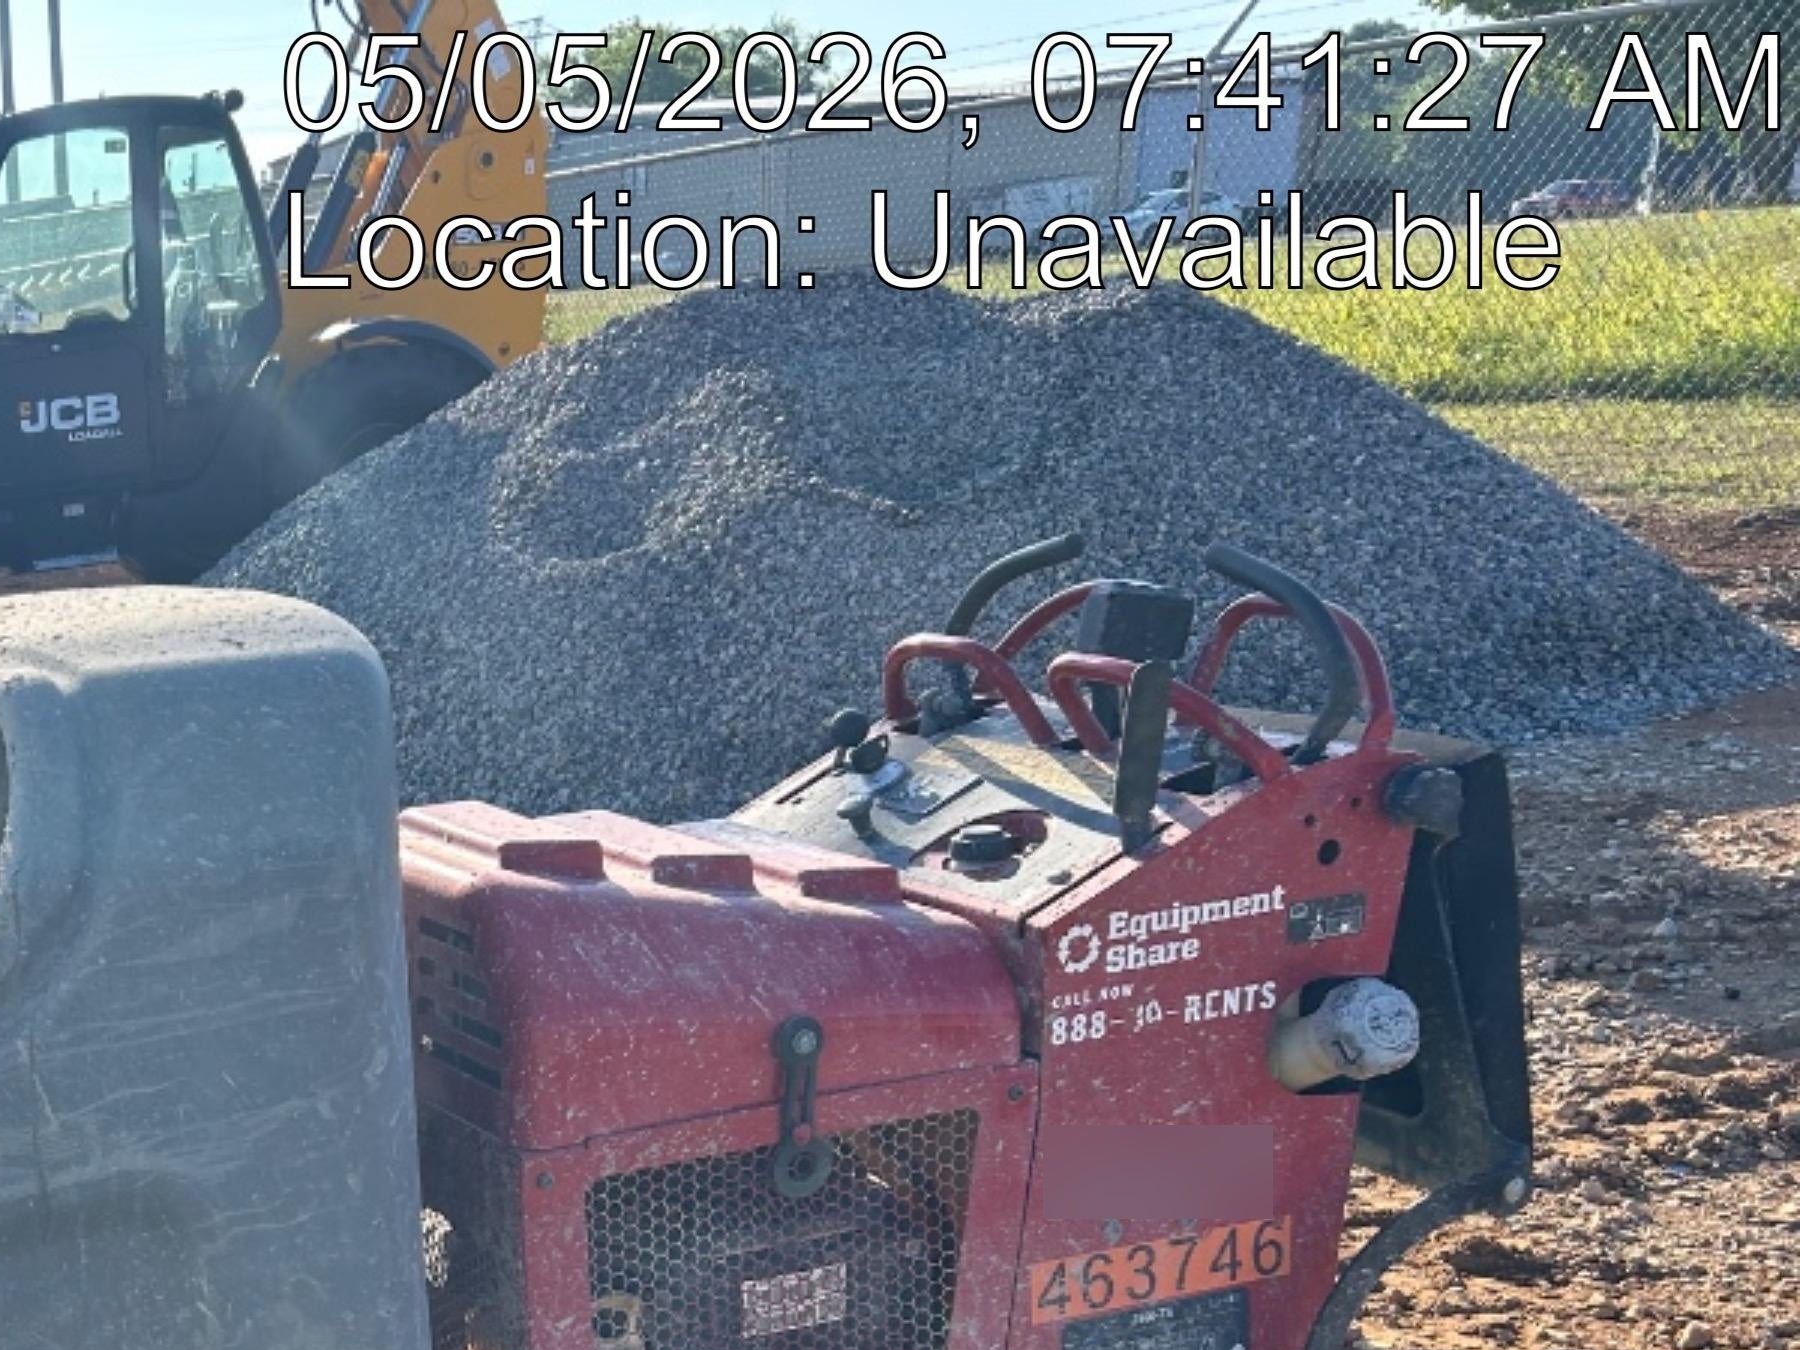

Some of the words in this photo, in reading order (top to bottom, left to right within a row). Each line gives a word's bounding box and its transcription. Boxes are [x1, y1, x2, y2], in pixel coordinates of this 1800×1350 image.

[20, 394, 120, 433] JCB
[1107, 884, 1286, 939] Equipment
[1105, 938, 1201, 973] Share
[1037, 1220, 1284, 1314] 463746
